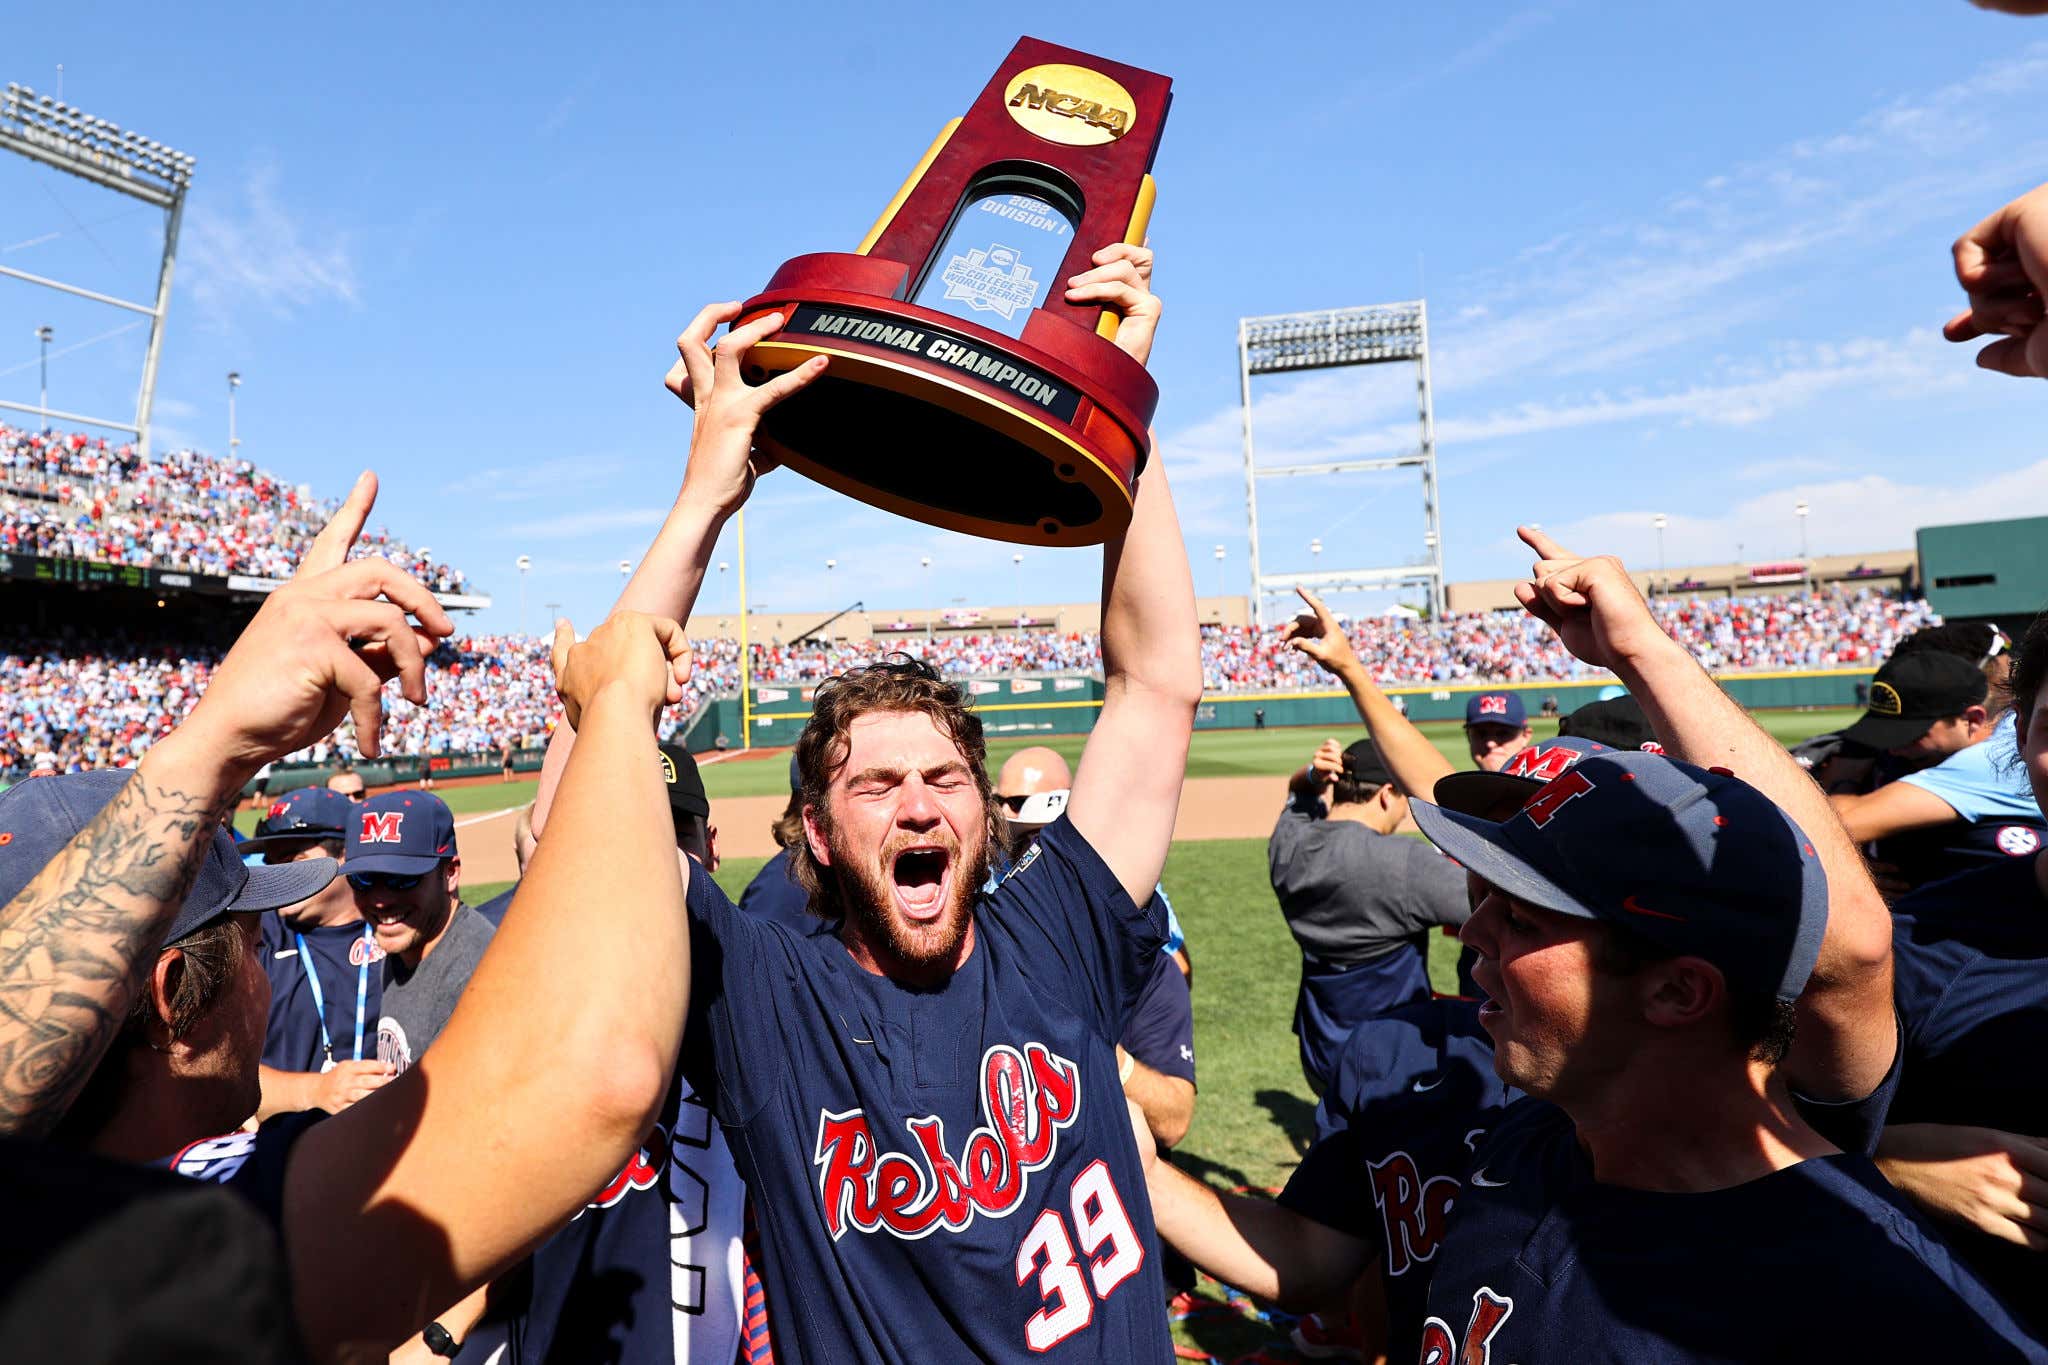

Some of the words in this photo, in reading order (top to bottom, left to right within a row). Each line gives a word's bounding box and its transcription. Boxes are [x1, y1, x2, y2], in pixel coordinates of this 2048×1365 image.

[1009, 83, 1128, 138] NCAA
[980, 199, 1058, 232] DIVISION
[1008, 195, 1051, 216] 2022
[945, 271, 987, 292] WORLD
[987, 283, 1031, 306] SERIES
[965, 269, 1018, 291] COLLEGE
[809, 314, 921, 353] NATIONAL
[925, 339, 1058, 406] CHAMPION
[1480, 696, 1507, 714] M
[1503, 746, 1583, 782] M
[359, 811, 404, 844] M
[814, 1041, 1081, 1242] Rebels
[1015, 1159, 1145, 1353] 39
